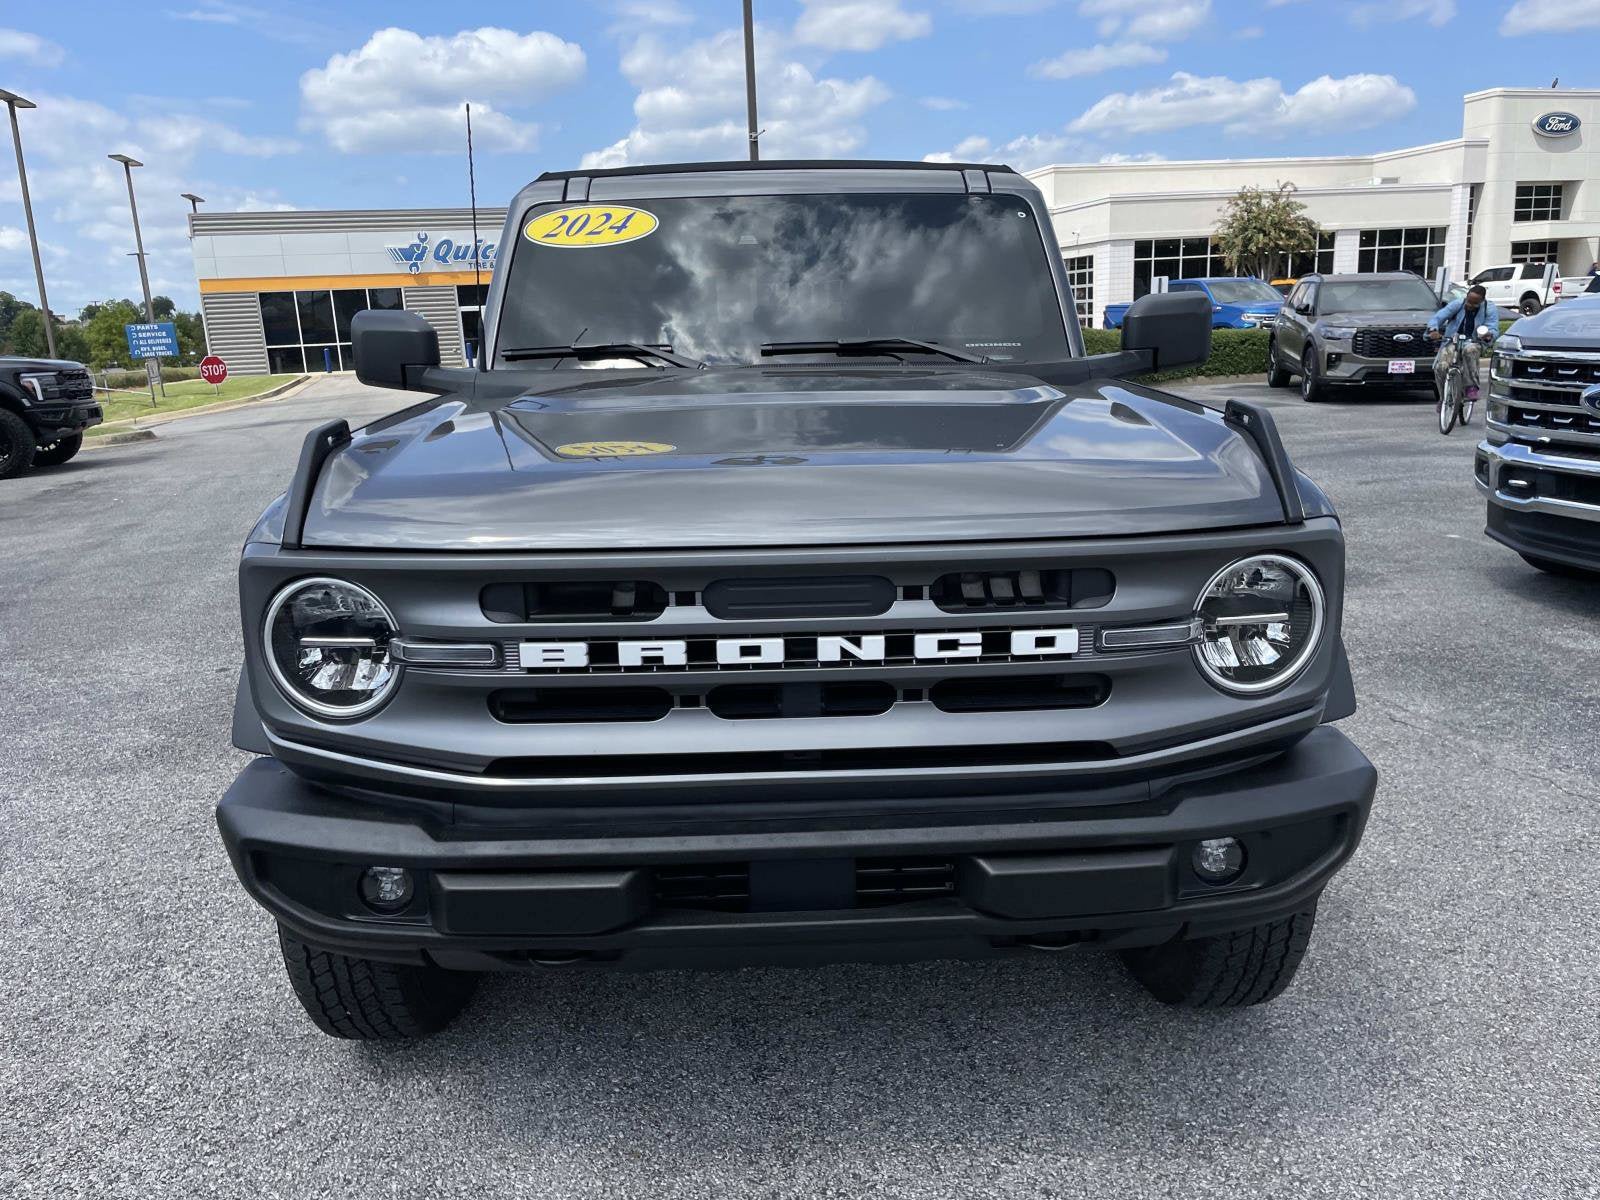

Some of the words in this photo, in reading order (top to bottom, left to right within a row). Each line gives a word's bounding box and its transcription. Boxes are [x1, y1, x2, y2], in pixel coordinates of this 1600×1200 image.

[1545, 116, 1573, 131] Ford
[541, 211, 637, 239] 2024
[433, 238, 500, 265] Quic
[468, 261, 488, 270] TIRE
[202, 364, 225, 376] STOP
[519, 628, 1079, 668] BRONCO
